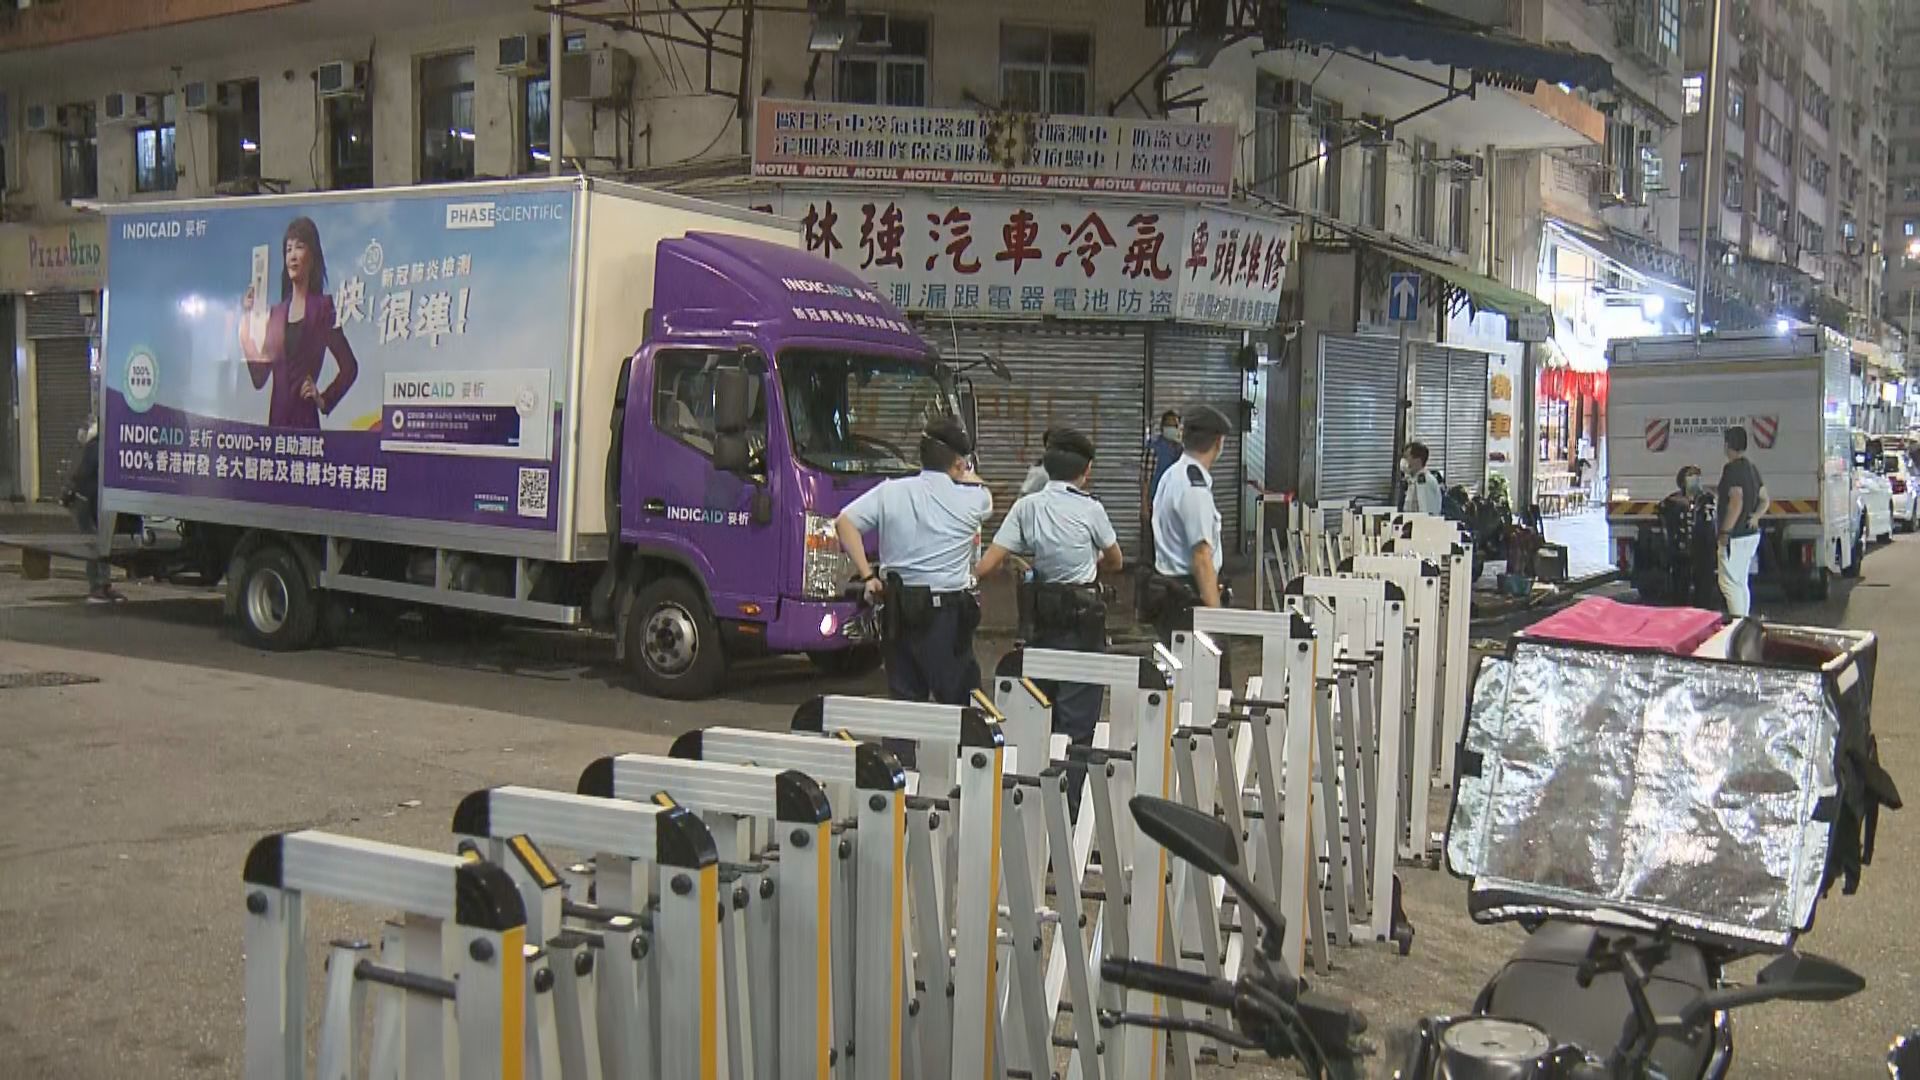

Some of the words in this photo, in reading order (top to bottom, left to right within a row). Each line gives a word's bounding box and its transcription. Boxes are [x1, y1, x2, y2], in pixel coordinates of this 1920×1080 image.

[755, 164, 799, 175] MOTUL
[803, 165, 849, 177] MOTUL
[853, 167, 898, 180] MOTUL
[903, 169, 947, 182] MOTUL
[951, 171, 995, 184] MOTUL
[1047, 176, 1090, 188] MOTUL
[1093, 178, 1136, 190] MOTUL
[1140, 180, 1182, 193] MOTUL
[1185, 182, 1227, 195] MOTUL
[122, 221, 181, 240] INDICAID
[752, 200, 1173, 280] 林強汽車冷氣
[1185, 220, 1287, 293] 車頭維修
[782, 278, 853, 298] INDICAID
[393, 382, 455, 399] INDICAID
[119, 424, 184, 446] INDICAID
[216, 433, 272, 452] COVID-19
[274, 435, 325, 458] 自助測試
[119, 450, 154, 471] 100%
[155, 451, 211, 476] 香港研發
[215, 456, 388, 492] 各大醫院及機構均有採用
[667, 505, 724, 524] INDICAID
